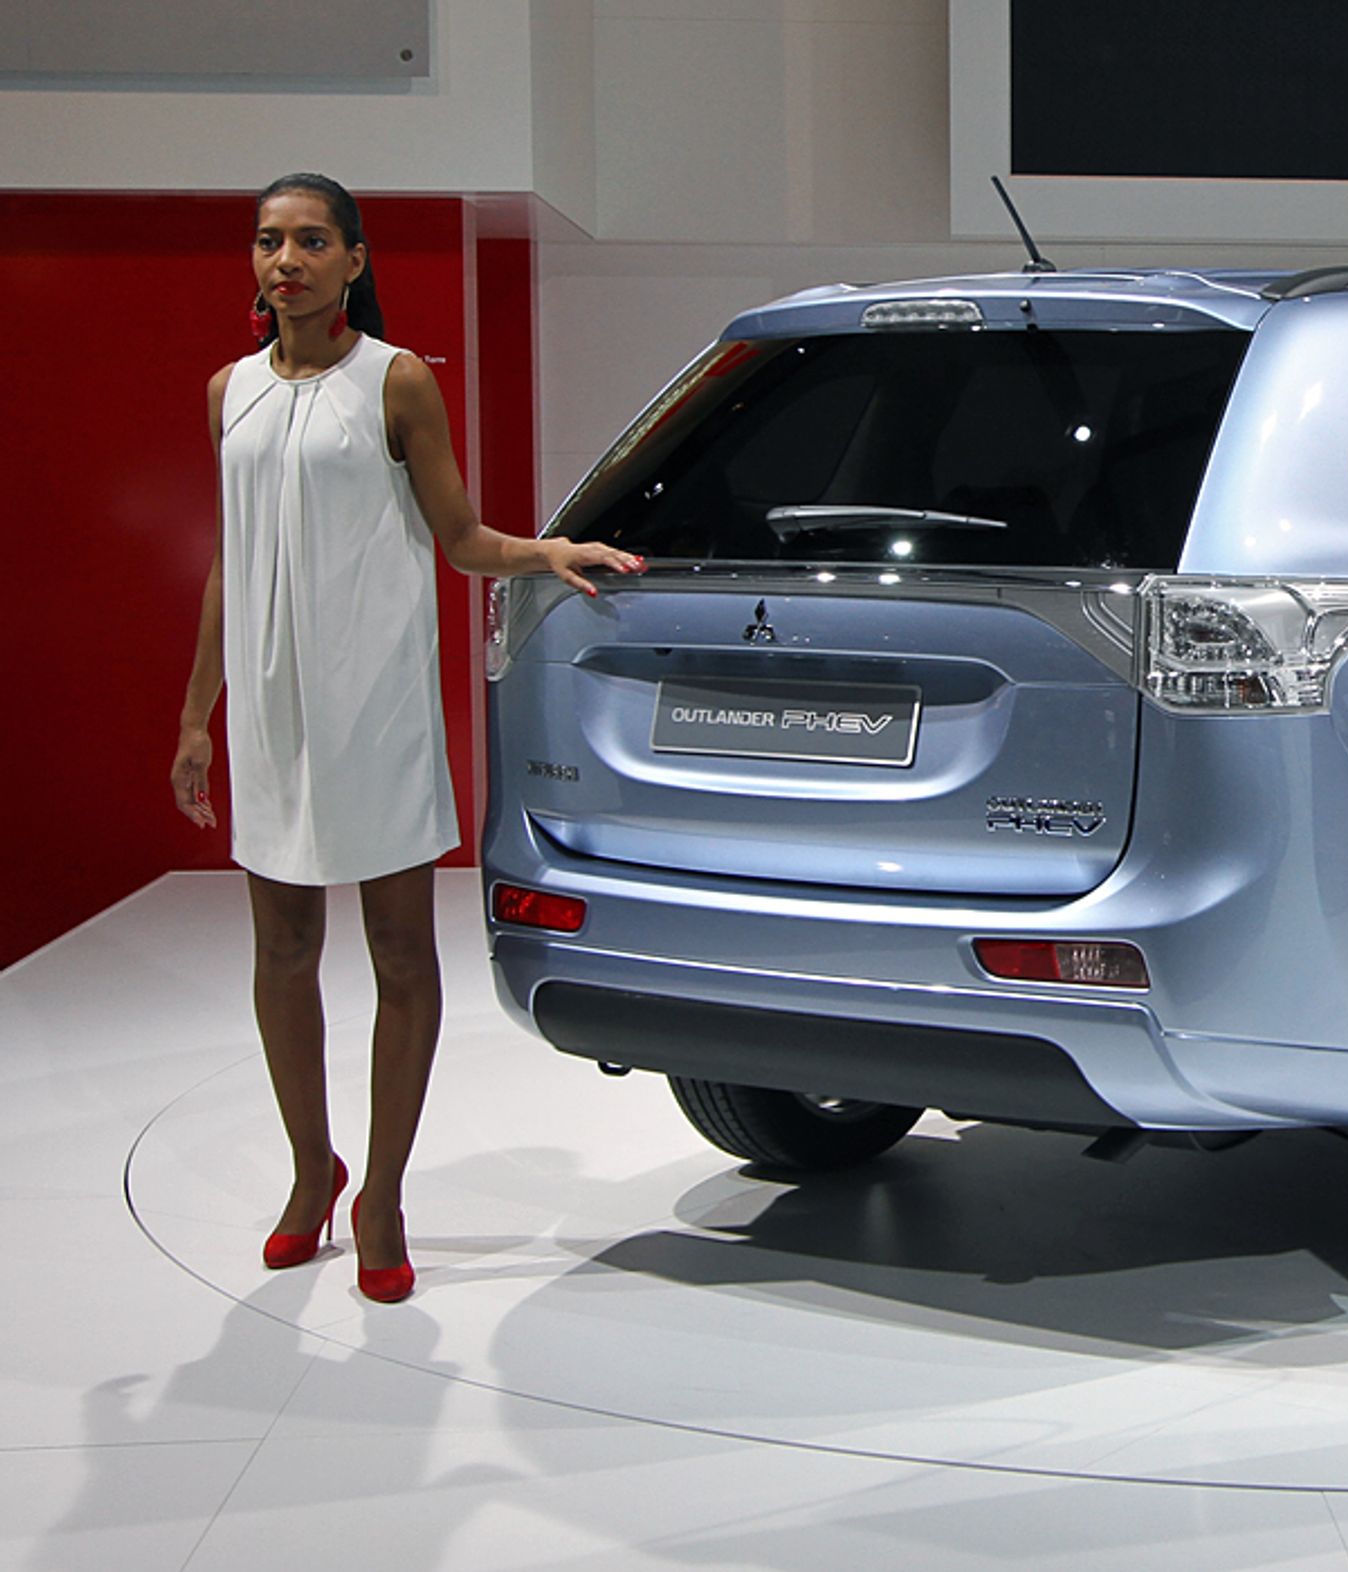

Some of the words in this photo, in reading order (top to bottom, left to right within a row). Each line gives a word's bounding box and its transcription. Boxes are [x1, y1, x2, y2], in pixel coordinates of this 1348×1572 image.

[671, 706, 776, 728] OUTLANDER
[780, 709, 894, 735] PHEV
[985, 811, 1107, 837] PHEV
